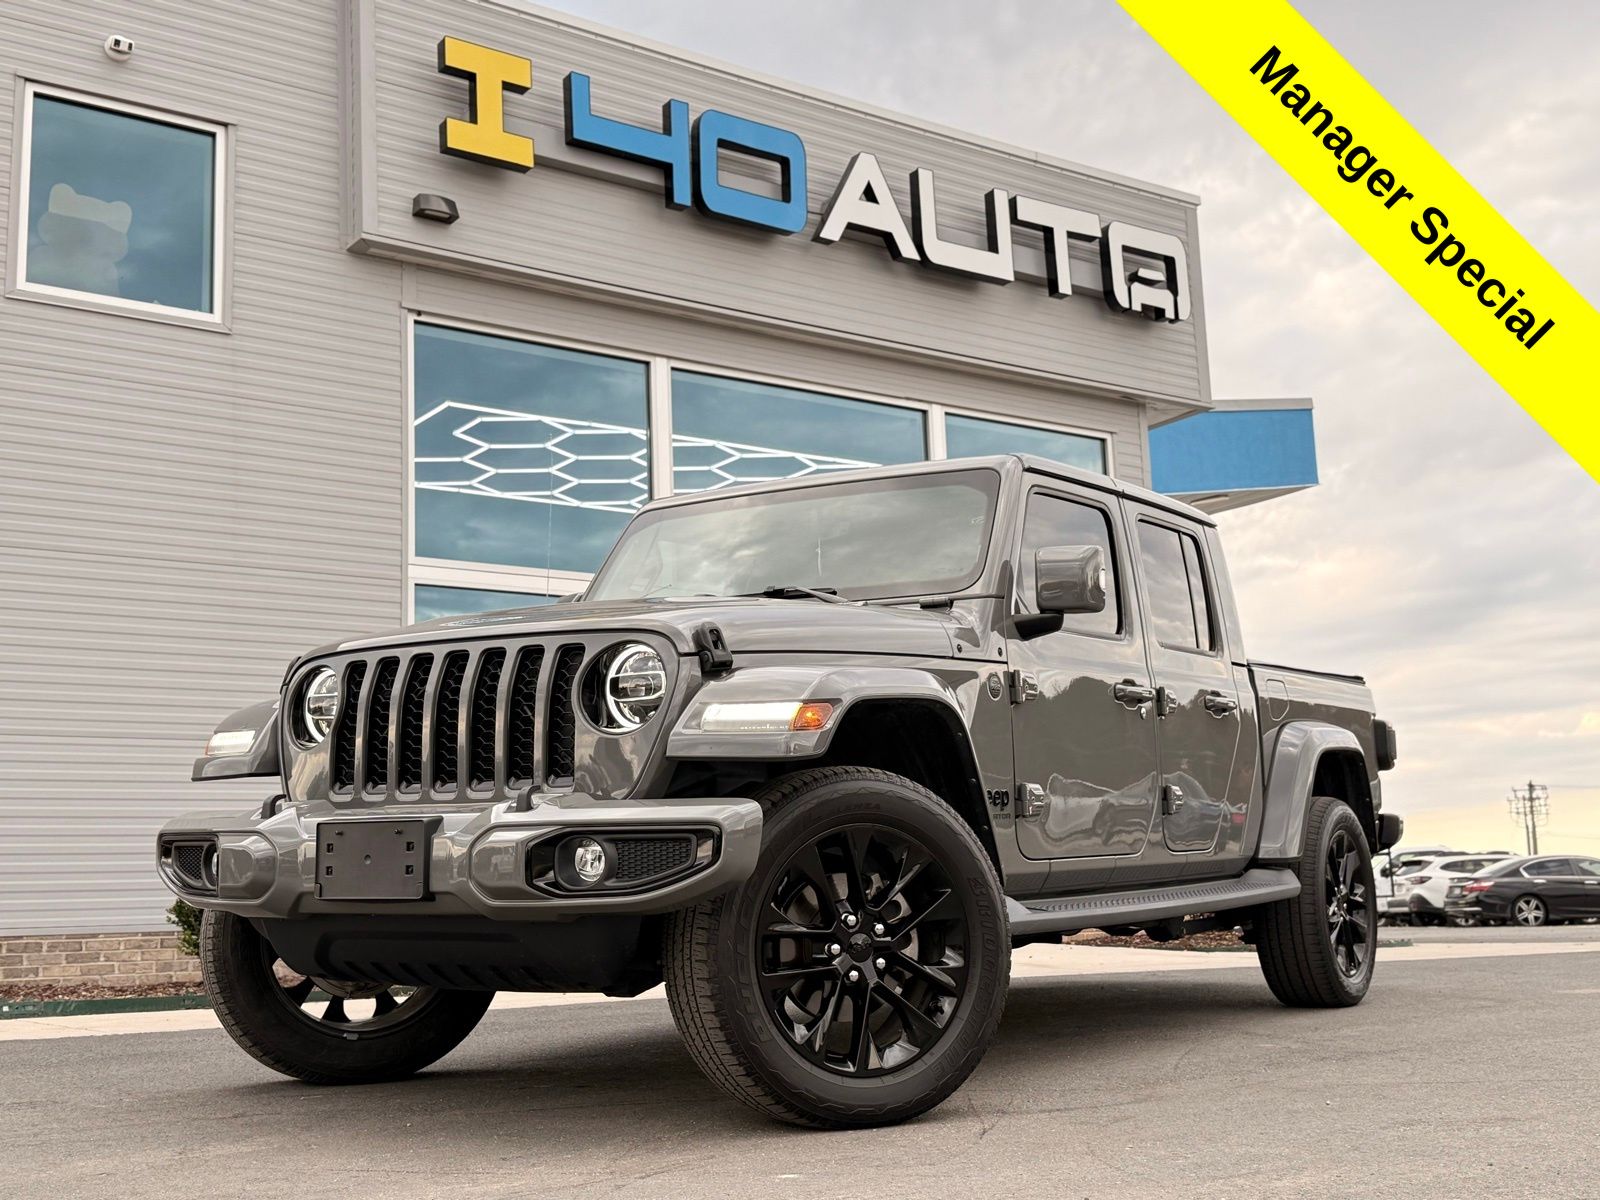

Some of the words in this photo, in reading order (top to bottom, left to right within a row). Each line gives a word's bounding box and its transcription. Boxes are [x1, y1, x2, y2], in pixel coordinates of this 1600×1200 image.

[438, 35, 535, 174] I
[563, 71, 808, 236] 40
[811, 152, 1191, 324] AUTO
[985, 789, 1010, 811] eep
